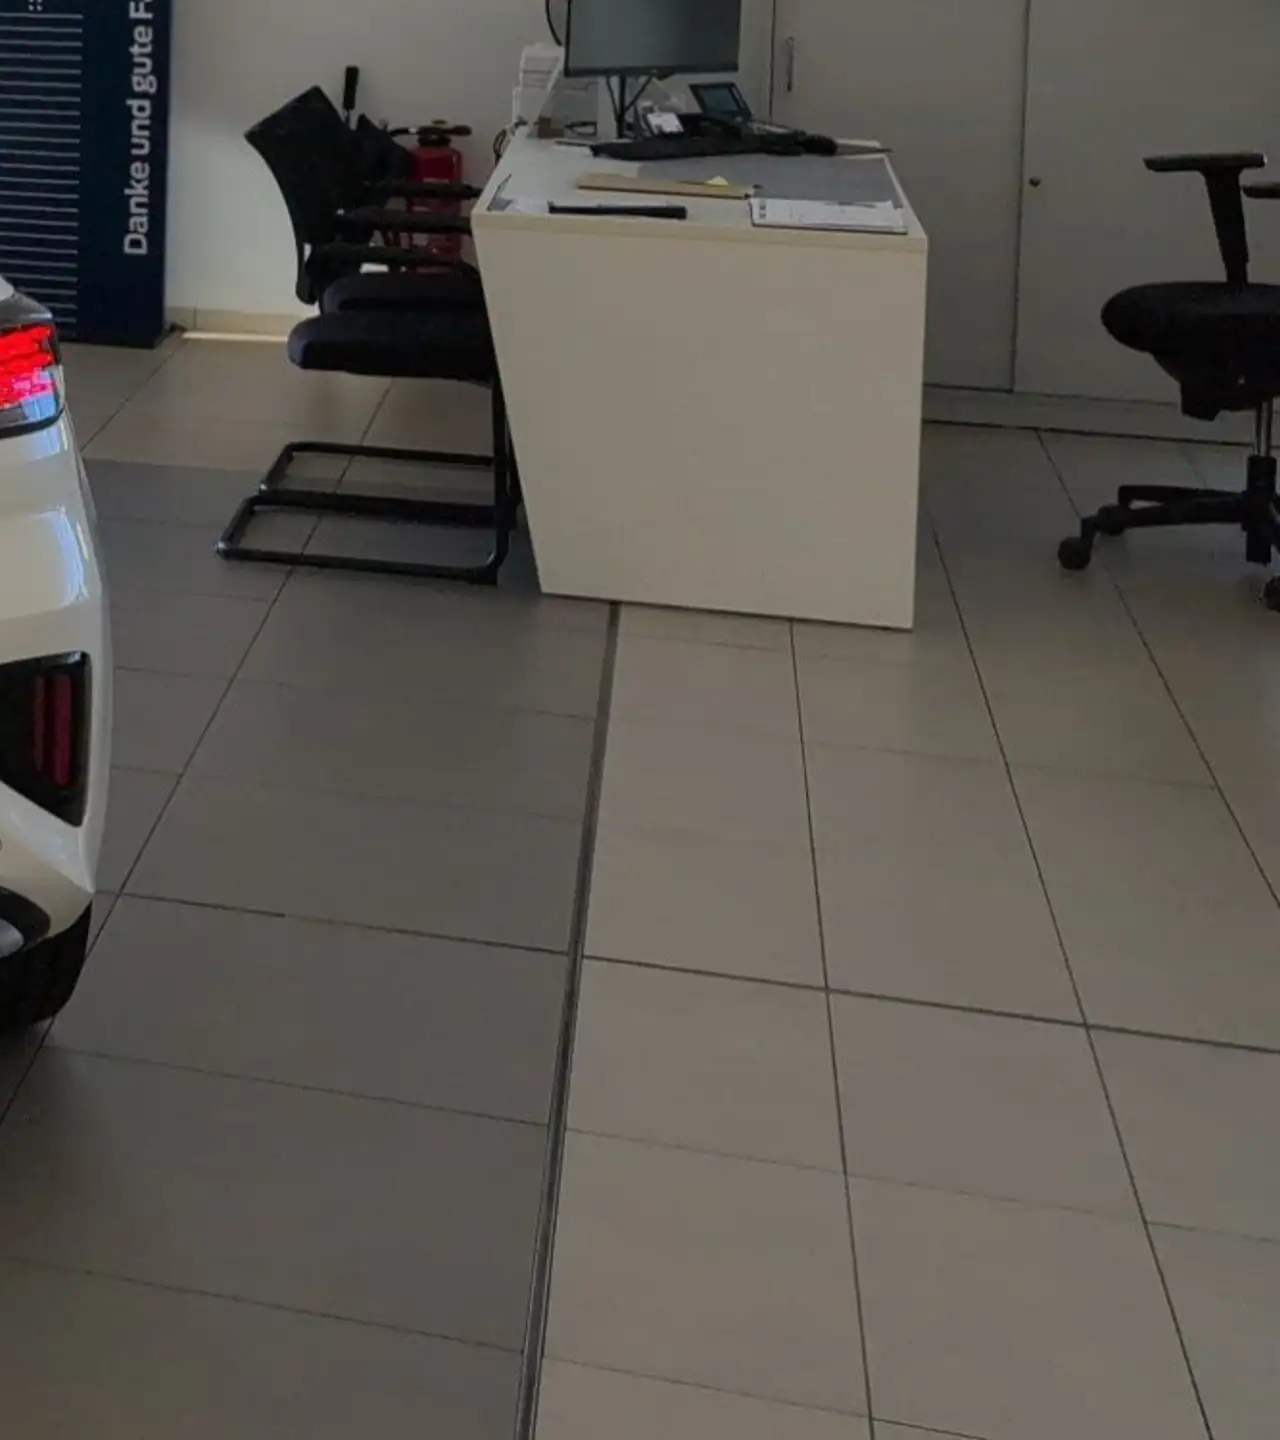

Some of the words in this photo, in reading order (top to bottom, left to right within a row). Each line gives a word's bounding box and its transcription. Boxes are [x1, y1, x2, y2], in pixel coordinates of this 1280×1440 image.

[128, 25, 157, 94] gute
[126, 99, 151, 155] und
[124, 162, 150, 255] Danke
